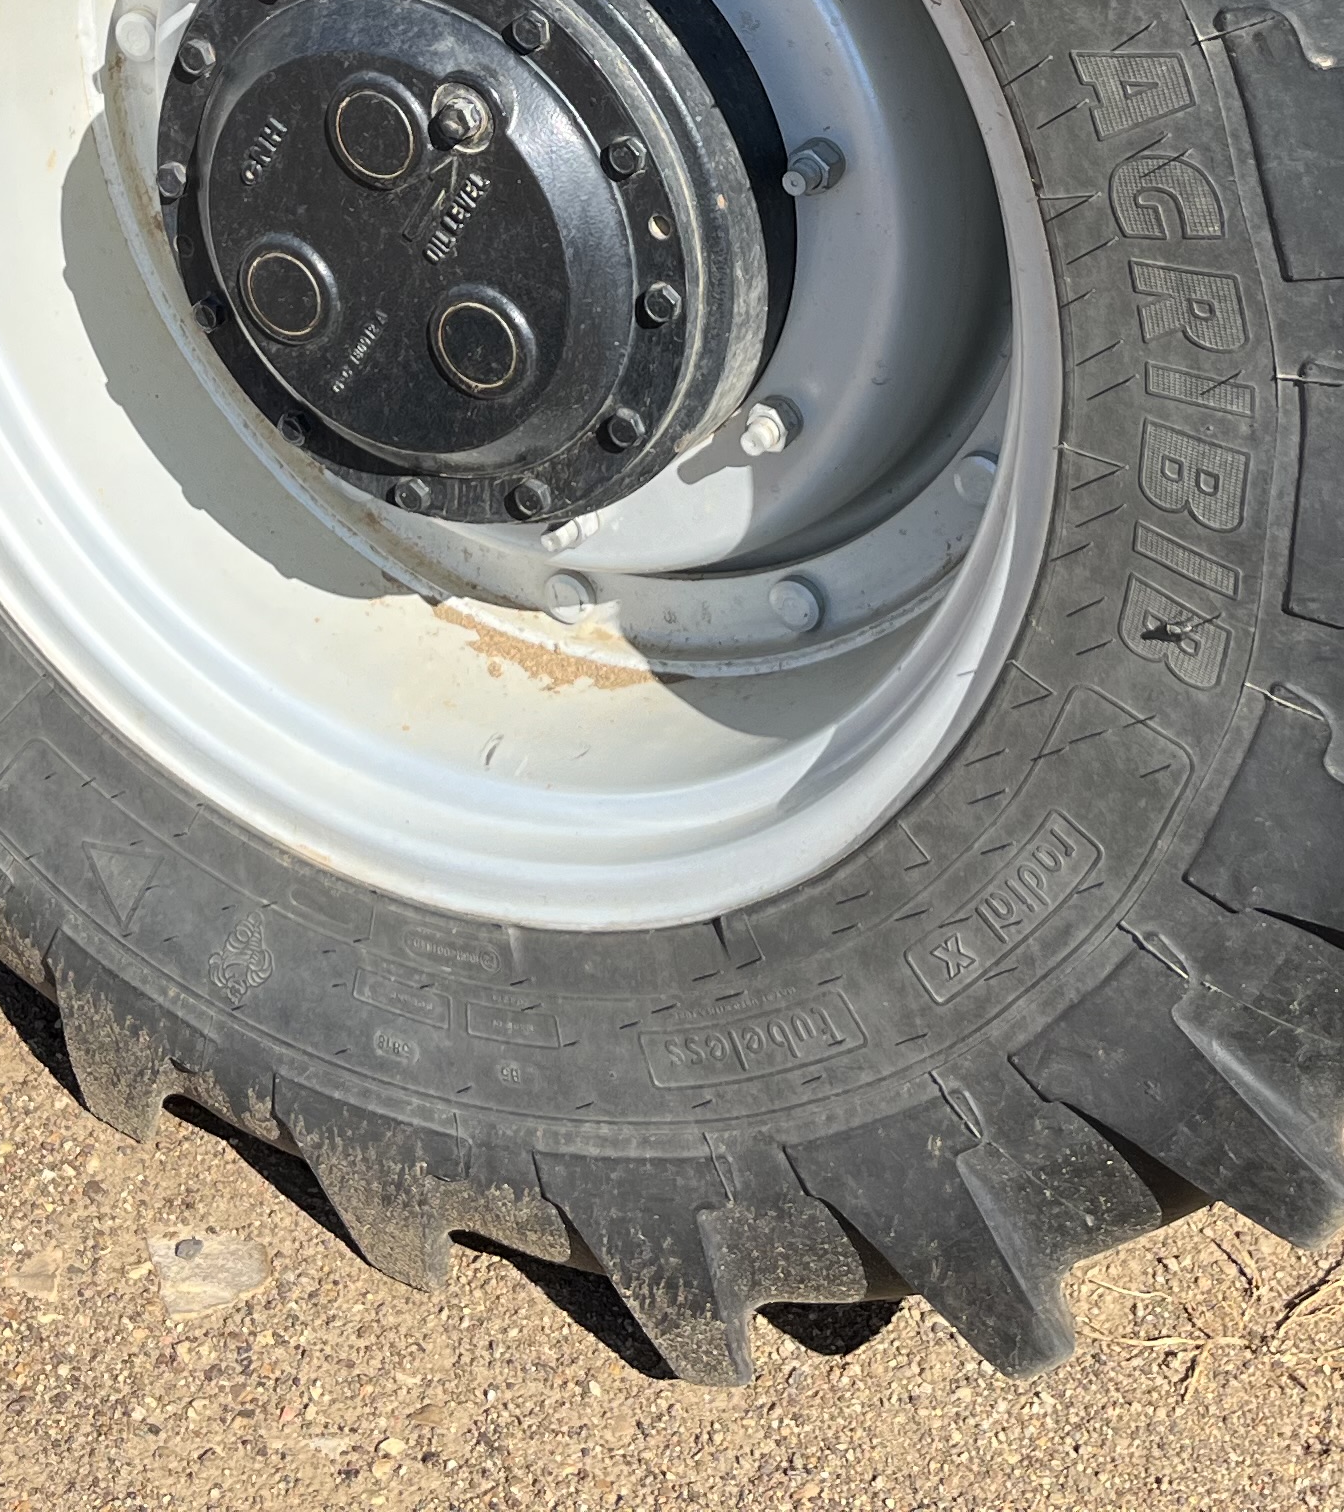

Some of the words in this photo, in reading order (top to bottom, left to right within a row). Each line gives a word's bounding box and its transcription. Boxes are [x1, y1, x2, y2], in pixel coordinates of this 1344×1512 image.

[422, 230, 457, 265] OIL
[440, 173, 491, 236] LEVEL
[1069, 49, 1256, 689] AGRIBIB
[975, 826, 1077, 944] radial
[663, 1003, 848, 1072] Tubeless
